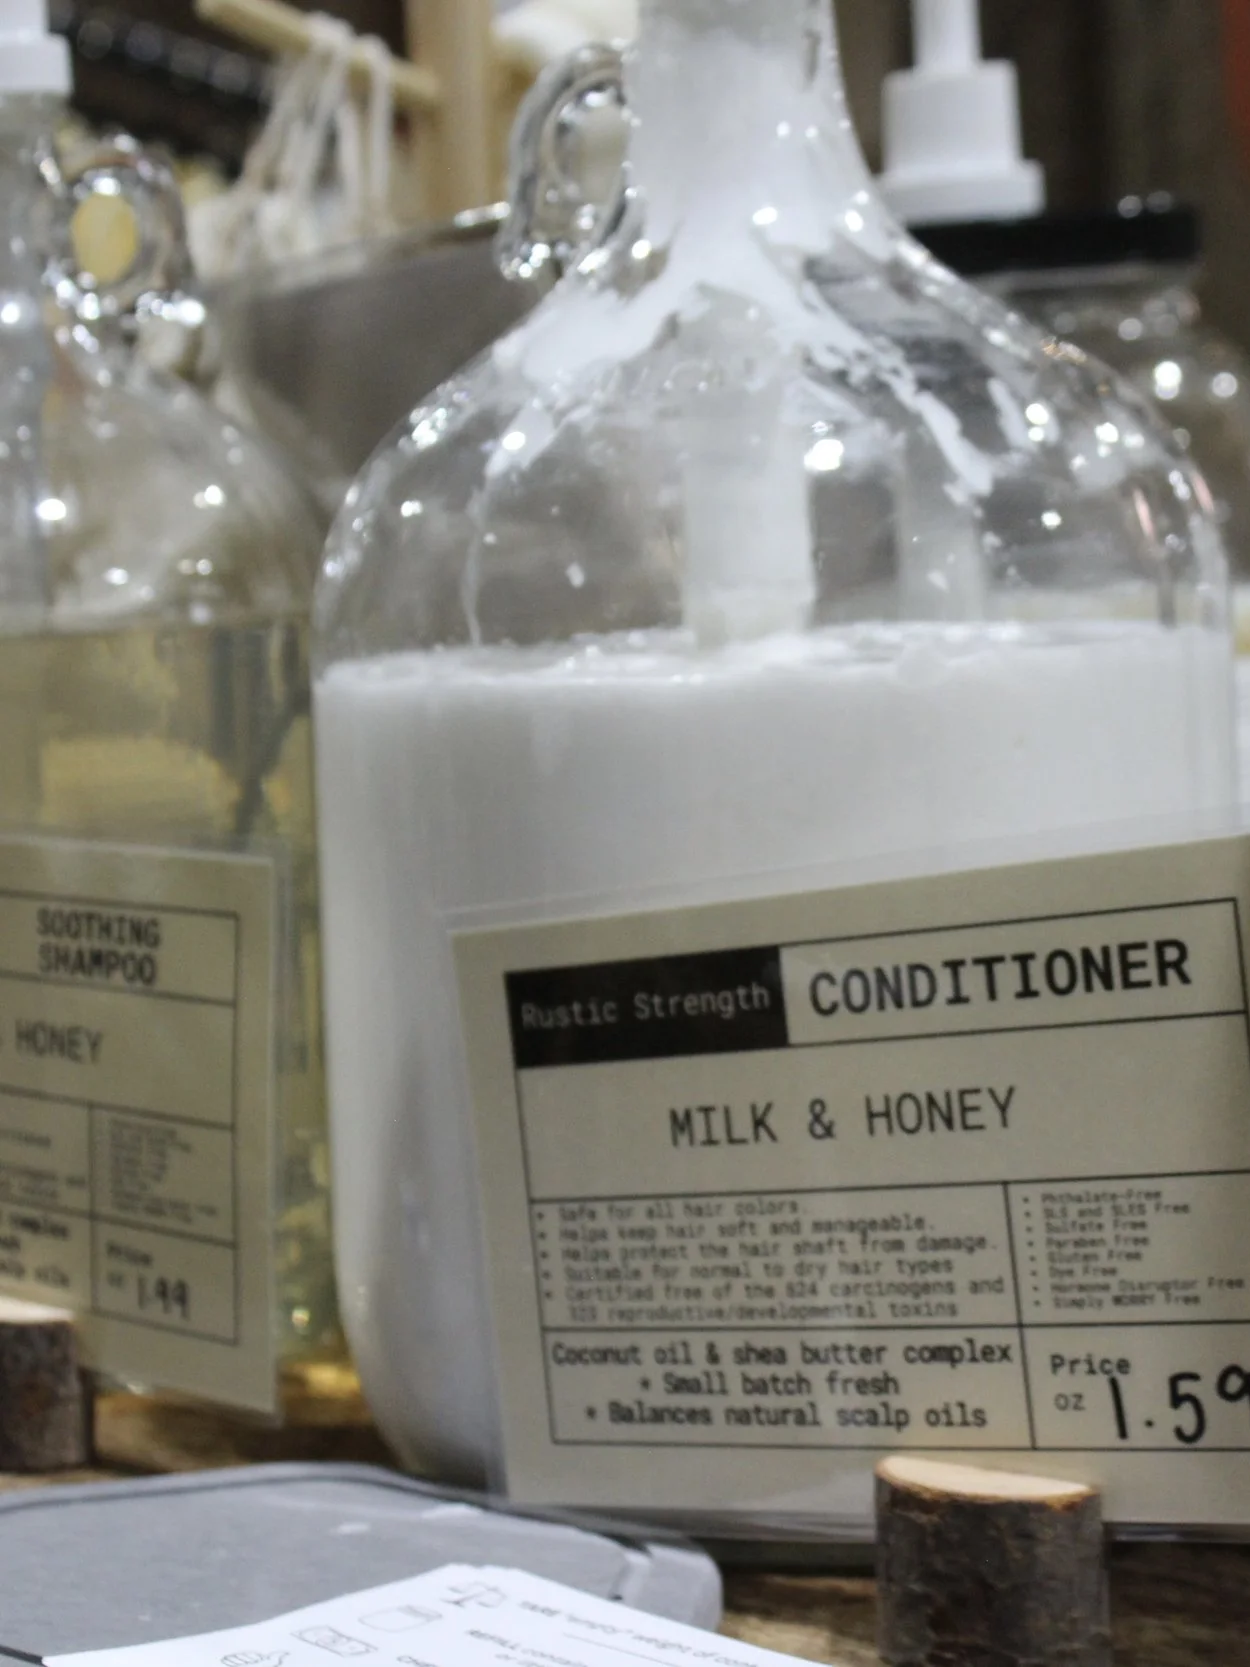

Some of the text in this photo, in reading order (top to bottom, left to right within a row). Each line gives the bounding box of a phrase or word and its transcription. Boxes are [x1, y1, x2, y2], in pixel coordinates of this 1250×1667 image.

[36, 908, 161, 949] SOOTHING
[38, 943, 157, 986] SHAMPOO
[809, 937, 1192, 1018] CONDITIONER
[520, 981, 771, 1031] Rustic Strength
[15, 1018, 102, 1064] HONEY
[668, 1084, 1017, 1148] MILK & HONEY
[559, 1199, 806, 1221] Safe for all hair colors.
[1077, 1203, 1104, 1218] and
[1154, 1200, 1192, 1215] Free
[559, 1213, 934, 1244] Helps keep hair soft and manageable.
[1112, 1218, 1149, 1231] Free
[561, 1233, 998, 1266] Helps protect the hair shaft from damage.
[1114, 1234, 1150, 1248] Free
[564, 1256, 954, 1281] Suitable for normal to dry hair types
[1107, 1249, 1143, 1262] Free
[1082, 1264, 1118, 1277] Free
[1207, 1276, 1246, 1290] Free
[564, 1285, 654, 1303] Certified
[663, 1284, 704, 1300] free
[712, 1282, 733, 1300] of
[743, 1281, 776, 1300] the
[829, 1278, 956, 1301] carcinogens
[968, 1277, 1006, 1295] and
[1164, 1292, 1201, 1306] Free
[888, 1300, 958, 1319] toxins
[551, 1337, 1013, 1370] Coconut oil & shea butter complex
[1050, 1354, 1132, 1376] Price
[662, 1371, 902, 1397] Small batch fresh
[608, 1401, 989, 1433] Balances natural scalp oils
